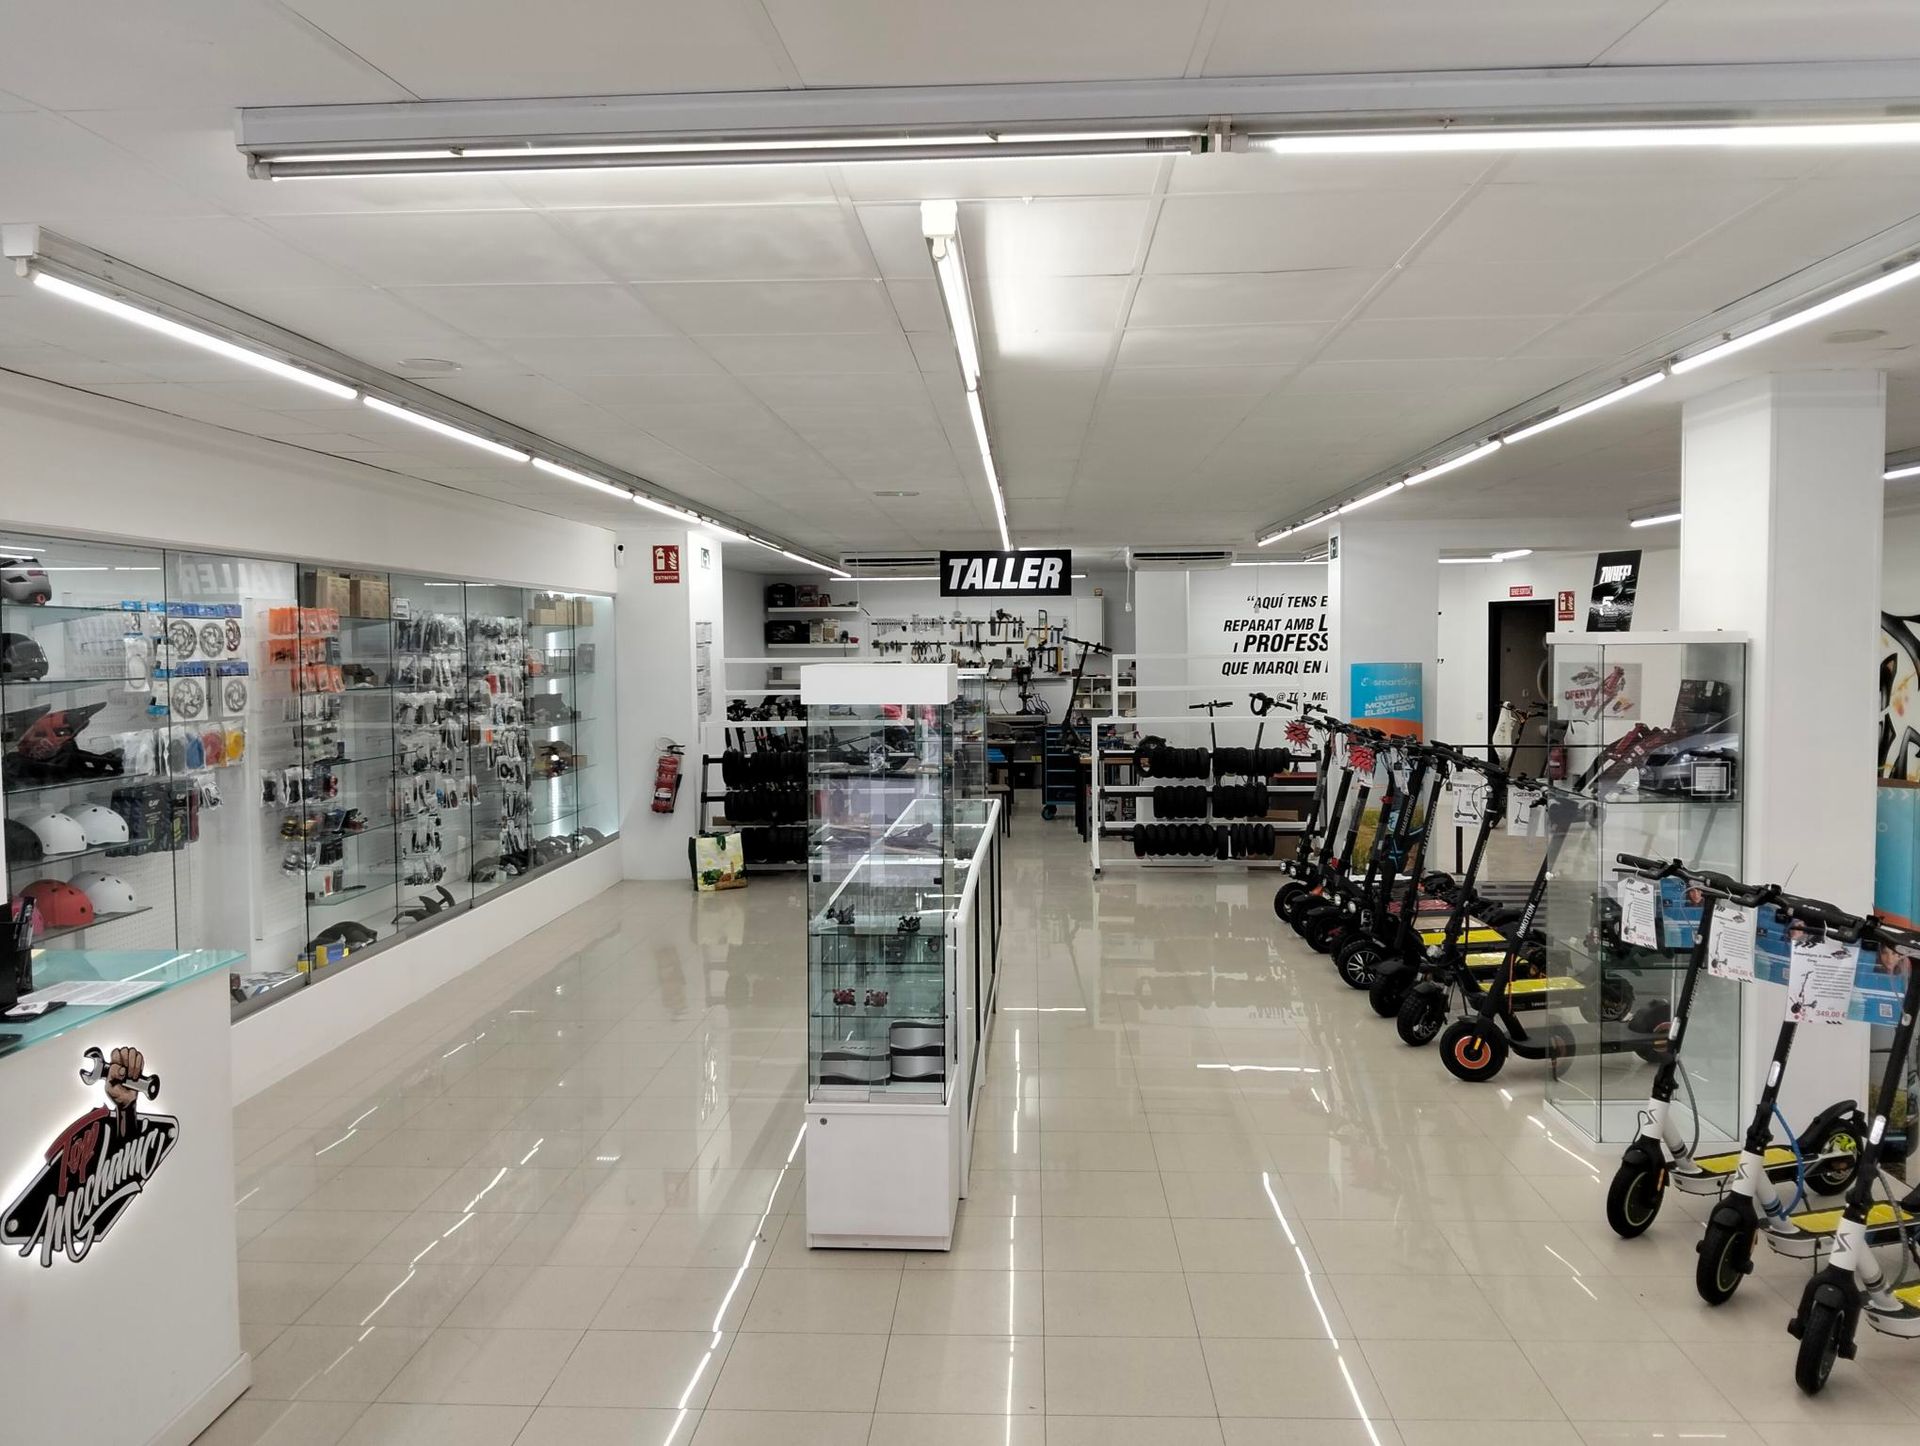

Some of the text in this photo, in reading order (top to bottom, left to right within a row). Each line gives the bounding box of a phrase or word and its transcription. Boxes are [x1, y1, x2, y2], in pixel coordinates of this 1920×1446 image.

[949, 557, 1063, 590] TALLER
[1287, 596, 1318, 608] TENS
[1223, 619, 1282, 632] REPARAT
[1284, 618, 1315, 631] AMB
[1221, 661, 1249, 676] QUE
[1365, 697, 1415, 709] MOVILIDAD
[45, 1104, 110, 1198] Top
[19, 1118, 166, 1268] Mechanic
